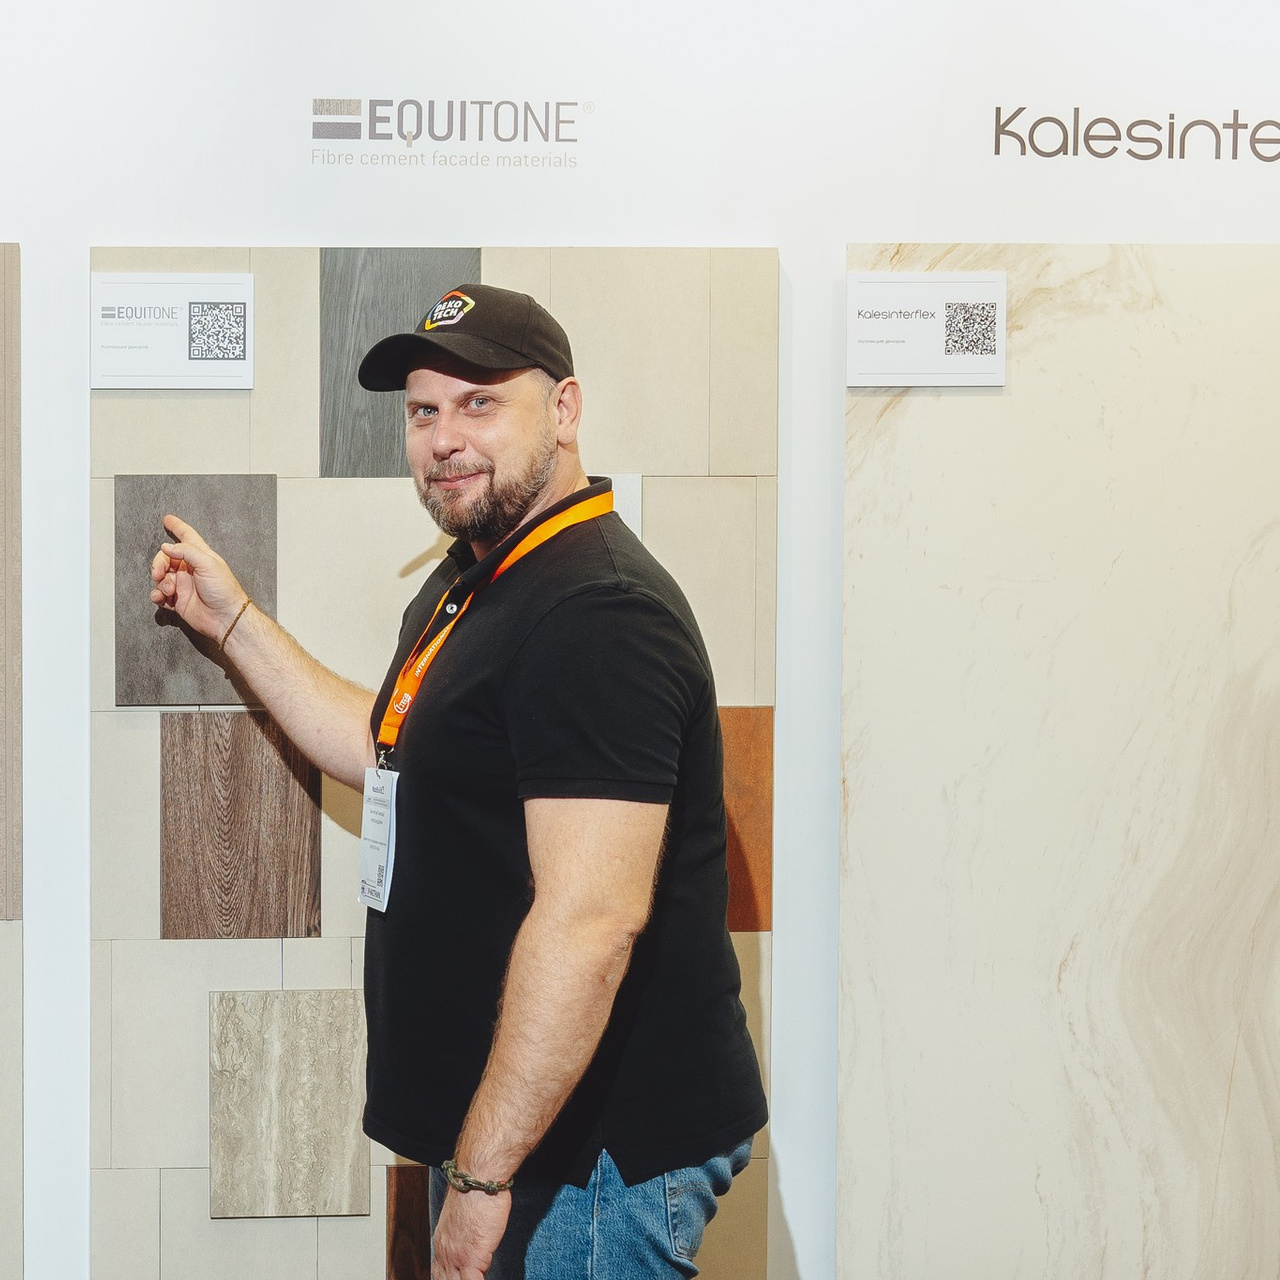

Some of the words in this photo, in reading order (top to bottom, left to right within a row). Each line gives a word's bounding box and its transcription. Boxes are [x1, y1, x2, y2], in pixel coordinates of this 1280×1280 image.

[368, 99, 578, 147] EQUITONE
[311, 149, 354, 166] Fibre
[359, 151, 426, 167] cement
[432, 150, 491, 168] facade
[496, 151, 578, 169] materials
[117, 306, 179, 321] EQUITONE
[434, 300, 463, 314] DEKO
[857, 309, 936, 320] Kalesinterflex
[432, 309, 459, 321] TECH
[414, 626, 451, 678] INTERNATIONAL
